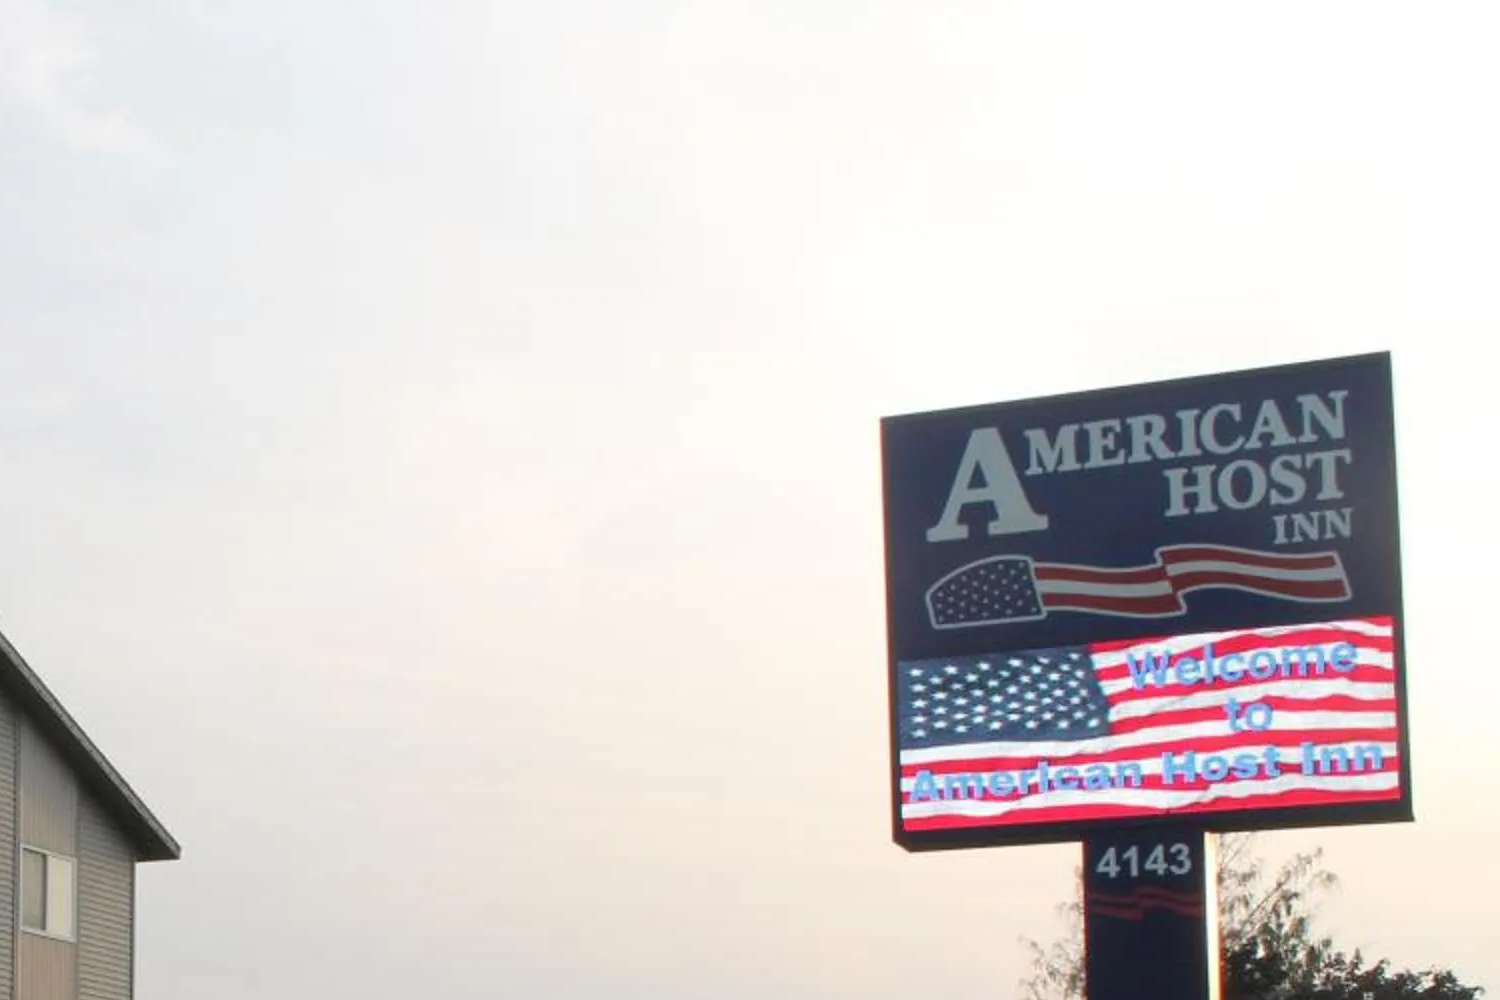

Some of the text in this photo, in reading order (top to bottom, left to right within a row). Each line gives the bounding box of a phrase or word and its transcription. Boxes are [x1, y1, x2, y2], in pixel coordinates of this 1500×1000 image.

[926, 390, 1348, 542] AMERICAN
[1163, 449, 1351, 516] HOST
[1273, 507, 1353, 544] INN
[1127, 641, 1357, 690] Welcome
[1223, 697, 1273, 731] to
[908, 742, 1383, 801] American Host Inn
[1096, 842, 1192, 878] 4143
